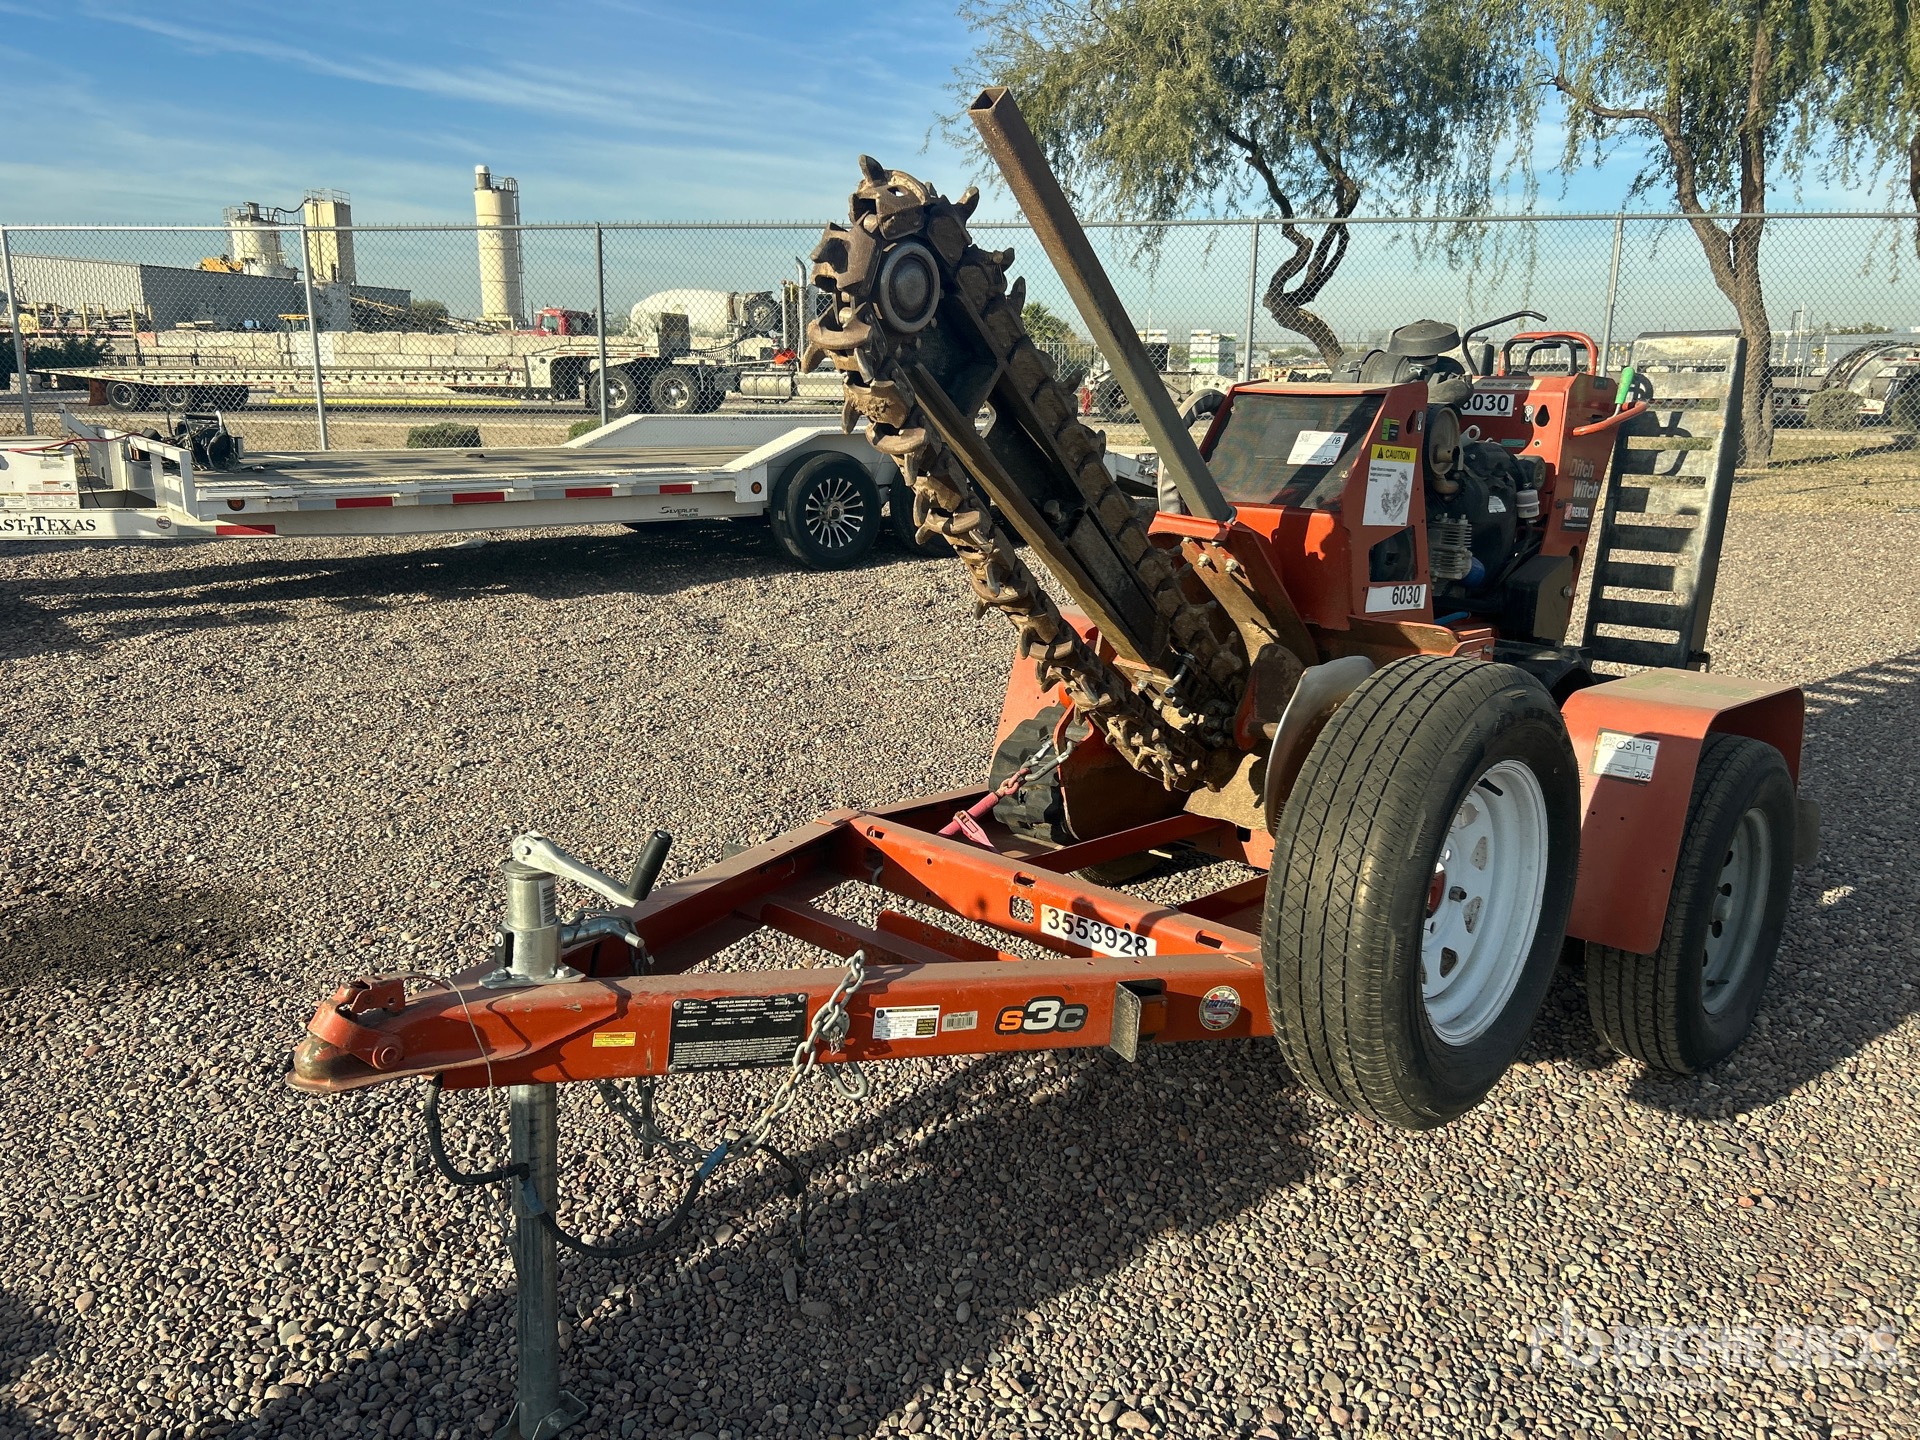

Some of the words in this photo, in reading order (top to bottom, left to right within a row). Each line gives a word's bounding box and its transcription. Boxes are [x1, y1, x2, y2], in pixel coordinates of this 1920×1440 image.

[1385, 449, 1410, 460] CAUTION
[1569, 459, 1595, 478] Ditch
[1573, 480, 1599, 498] Witch
[1571, 506, 1589, 518] RENTAL
[24, 525, 77, 535] TRAILERS
[30, 516, 96, 531] TEXAS
[1392, 585, 1420, 605] 6030
[1047, 908, 1148, 956] 3553928
